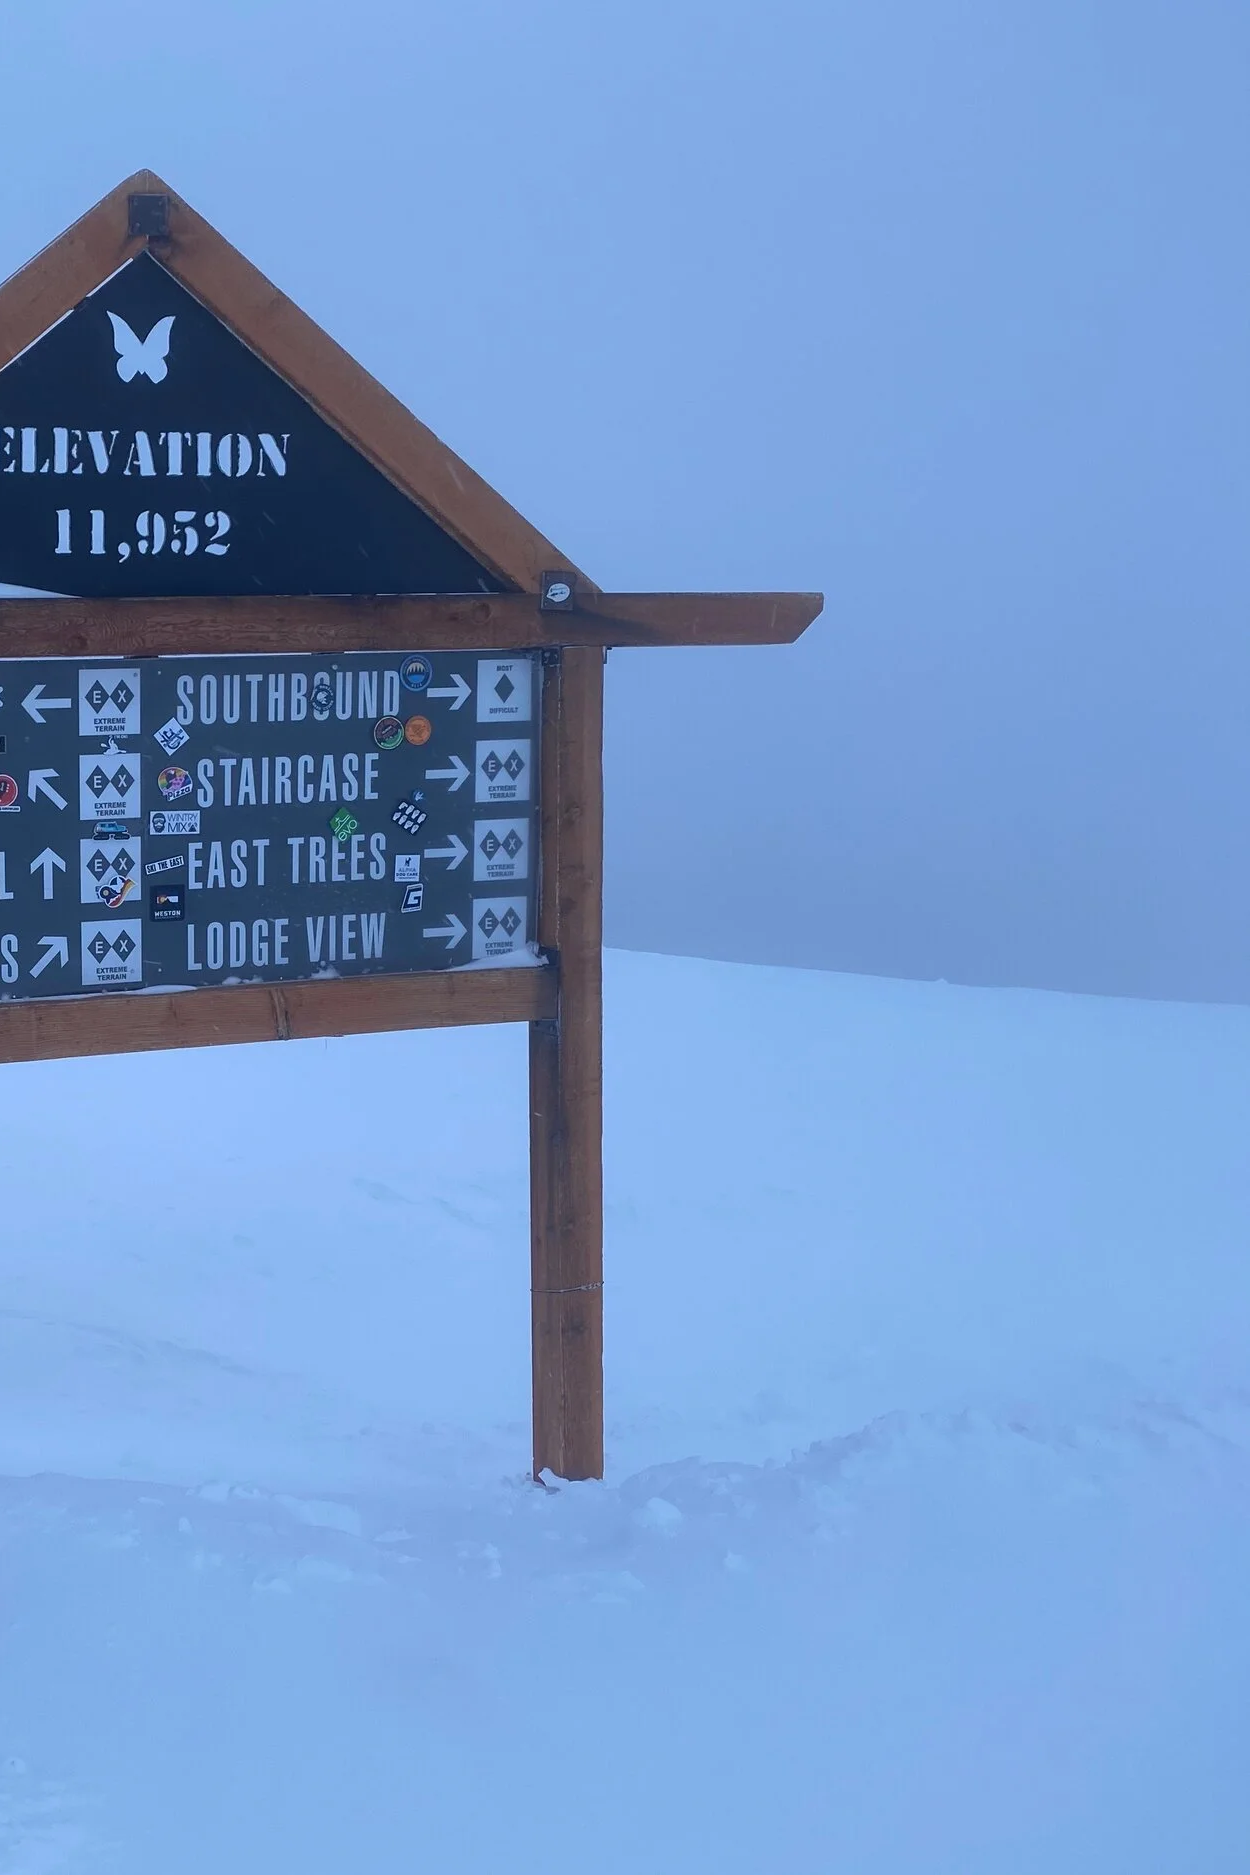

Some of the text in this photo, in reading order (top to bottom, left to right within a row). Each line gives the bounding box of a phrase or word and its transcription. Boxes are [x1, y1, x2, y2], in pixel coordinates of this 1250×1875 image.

[55, 509, 231, 563] 11,952
[93, 689, 127, 704] E X
[177, 670, 400, 726] SOUTHBOUND
[93, 717, 126, 725] EXTREME
[94, 725, 126, 733] TERRAIN
[488, 759, 518, 773] E X
[93, 774, 127, 789] E X
[197, 752, 380, 808] STAIRCASE
[94, 802, 126, 810] EXTREME
[95, 809, 126, 817] TERRAIN
[167, 813, 198, 822] WINTRY
[167, 822, 188, 833] MIX
[486, 838, 517, 852] E X
[94, 858, 128, 872] E X
[147, 856, 183, 874] SKI THE EAST
[188, 832, 387, 890] EAST TREES
[486, 863, 515, 871] EXTREME
[487, 870, 514, 878] TERRAIN
[484, 916, 515, 930] E X
[95, 940, 129, 954] E X
[187, 912, 386, 971] LODGE VIEW
[96, 966, 128, 974] EXTREME
[97, 973, 127, 981] TERRAIN
